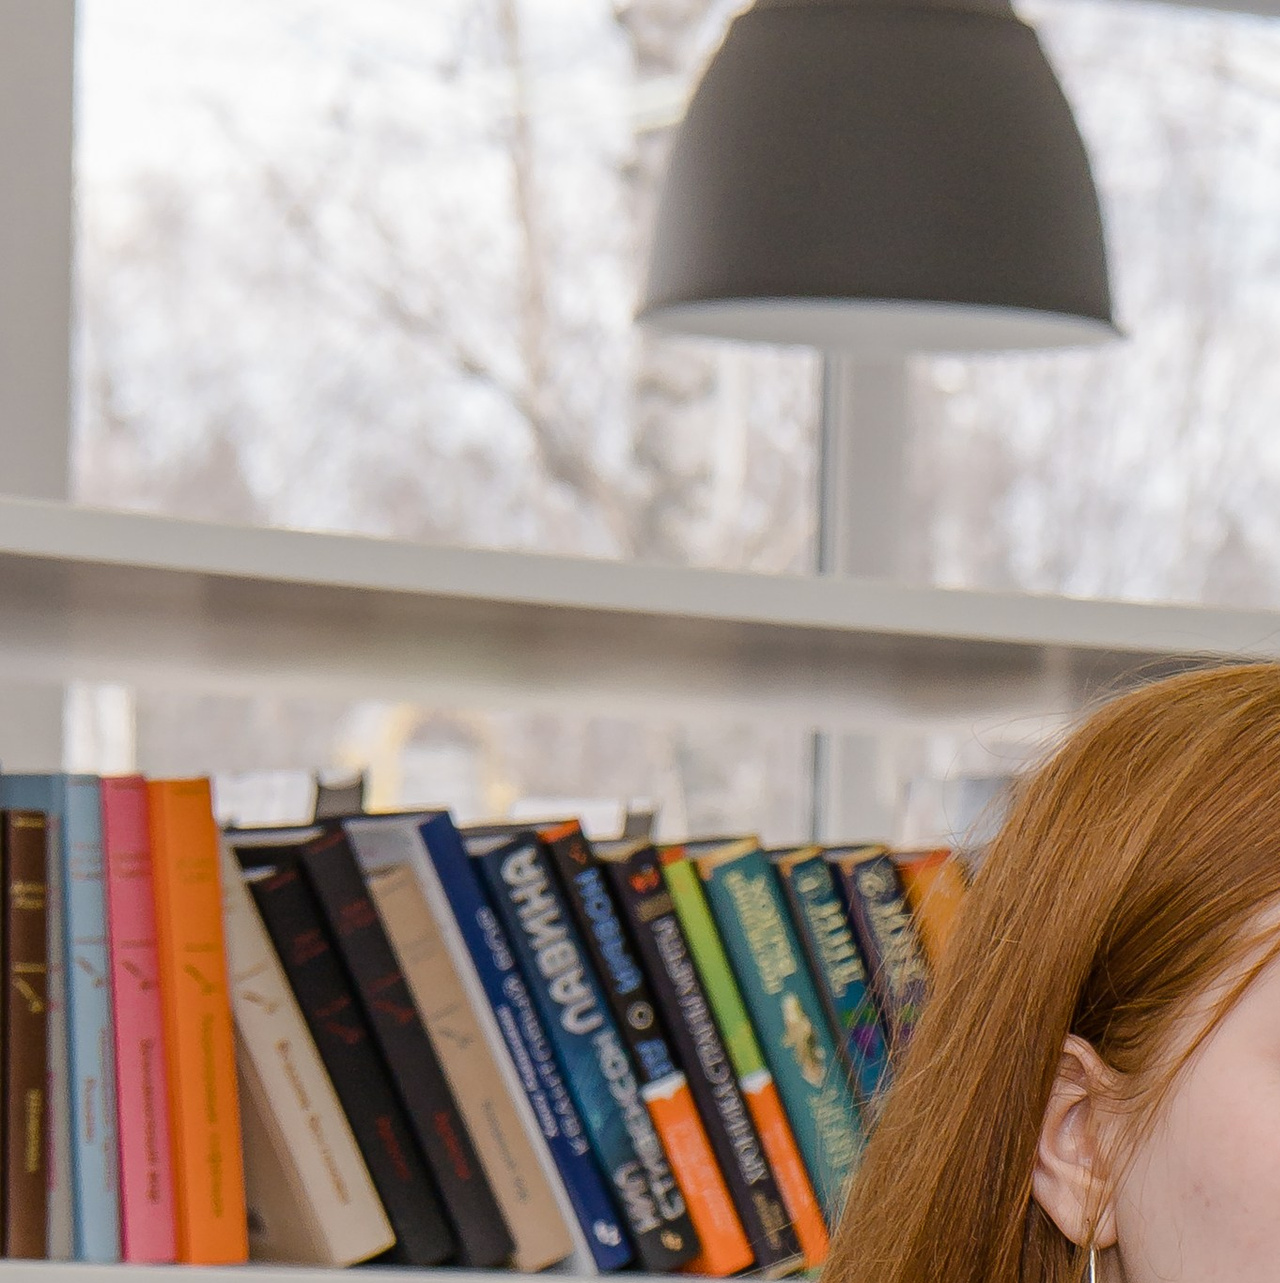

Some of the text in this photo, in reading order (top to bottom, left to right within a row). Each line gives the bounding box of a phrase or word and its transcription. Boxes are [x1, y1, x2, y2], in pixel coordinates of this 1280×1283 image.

[499, 845, 604, 1035] ЛАВИНА
[592, 1029, 685, 1221] СТИВЕНСОН
[614, 1162, 659, 1233] НИЛ
